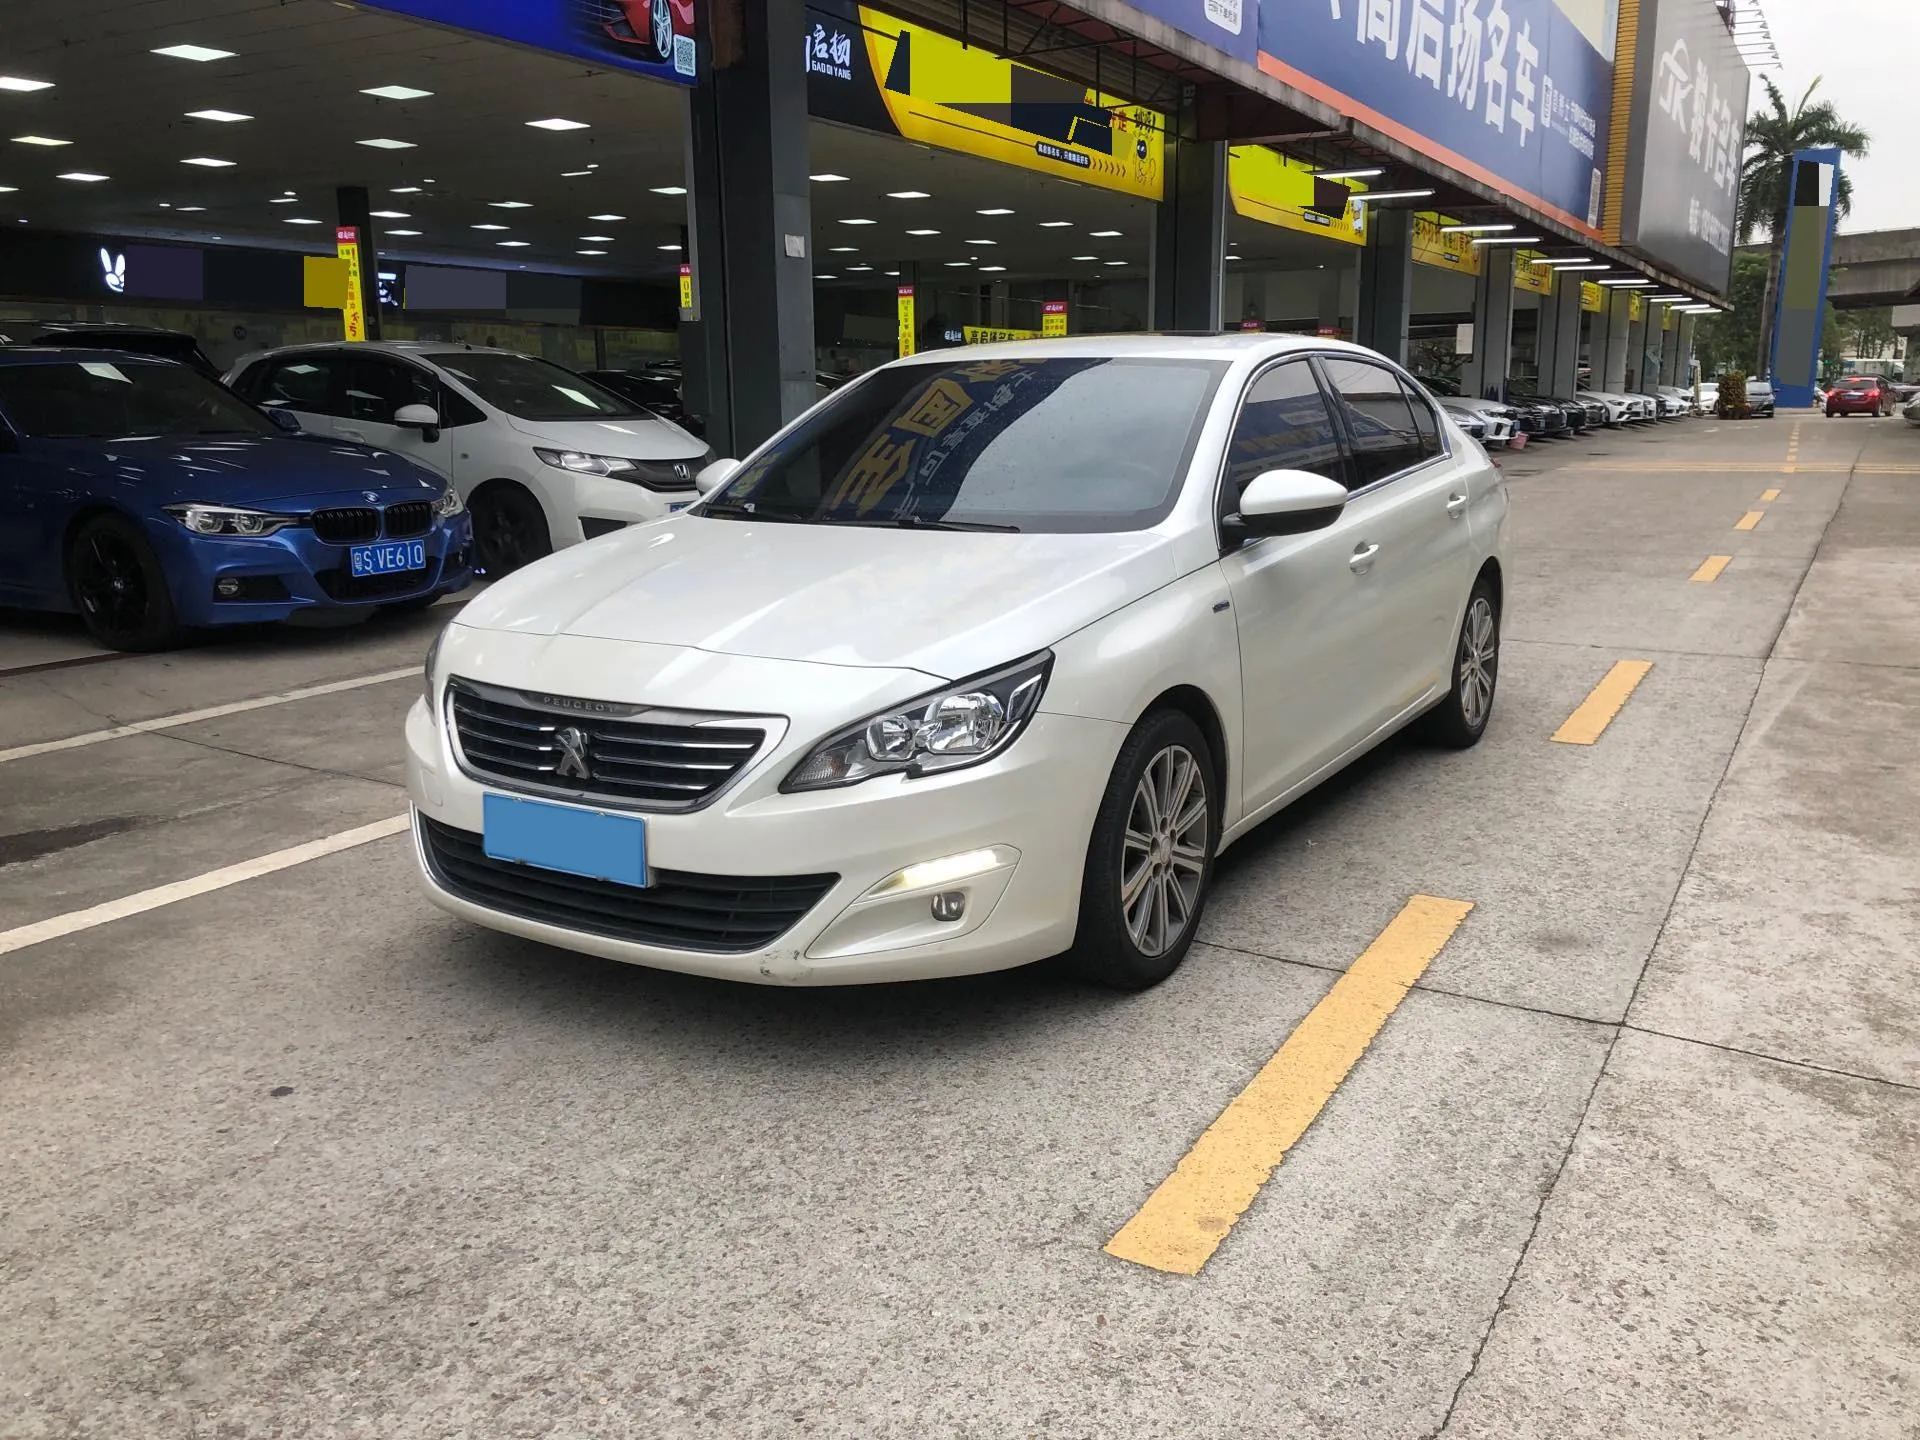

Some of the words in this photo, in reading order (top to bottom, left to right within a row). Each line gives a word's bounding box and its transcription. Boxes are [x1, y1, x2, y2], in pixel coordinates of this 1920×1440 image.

[1331, 0, 1540, 147] 启扬名车
[544, 696, 616, 713] PEUGEOT
